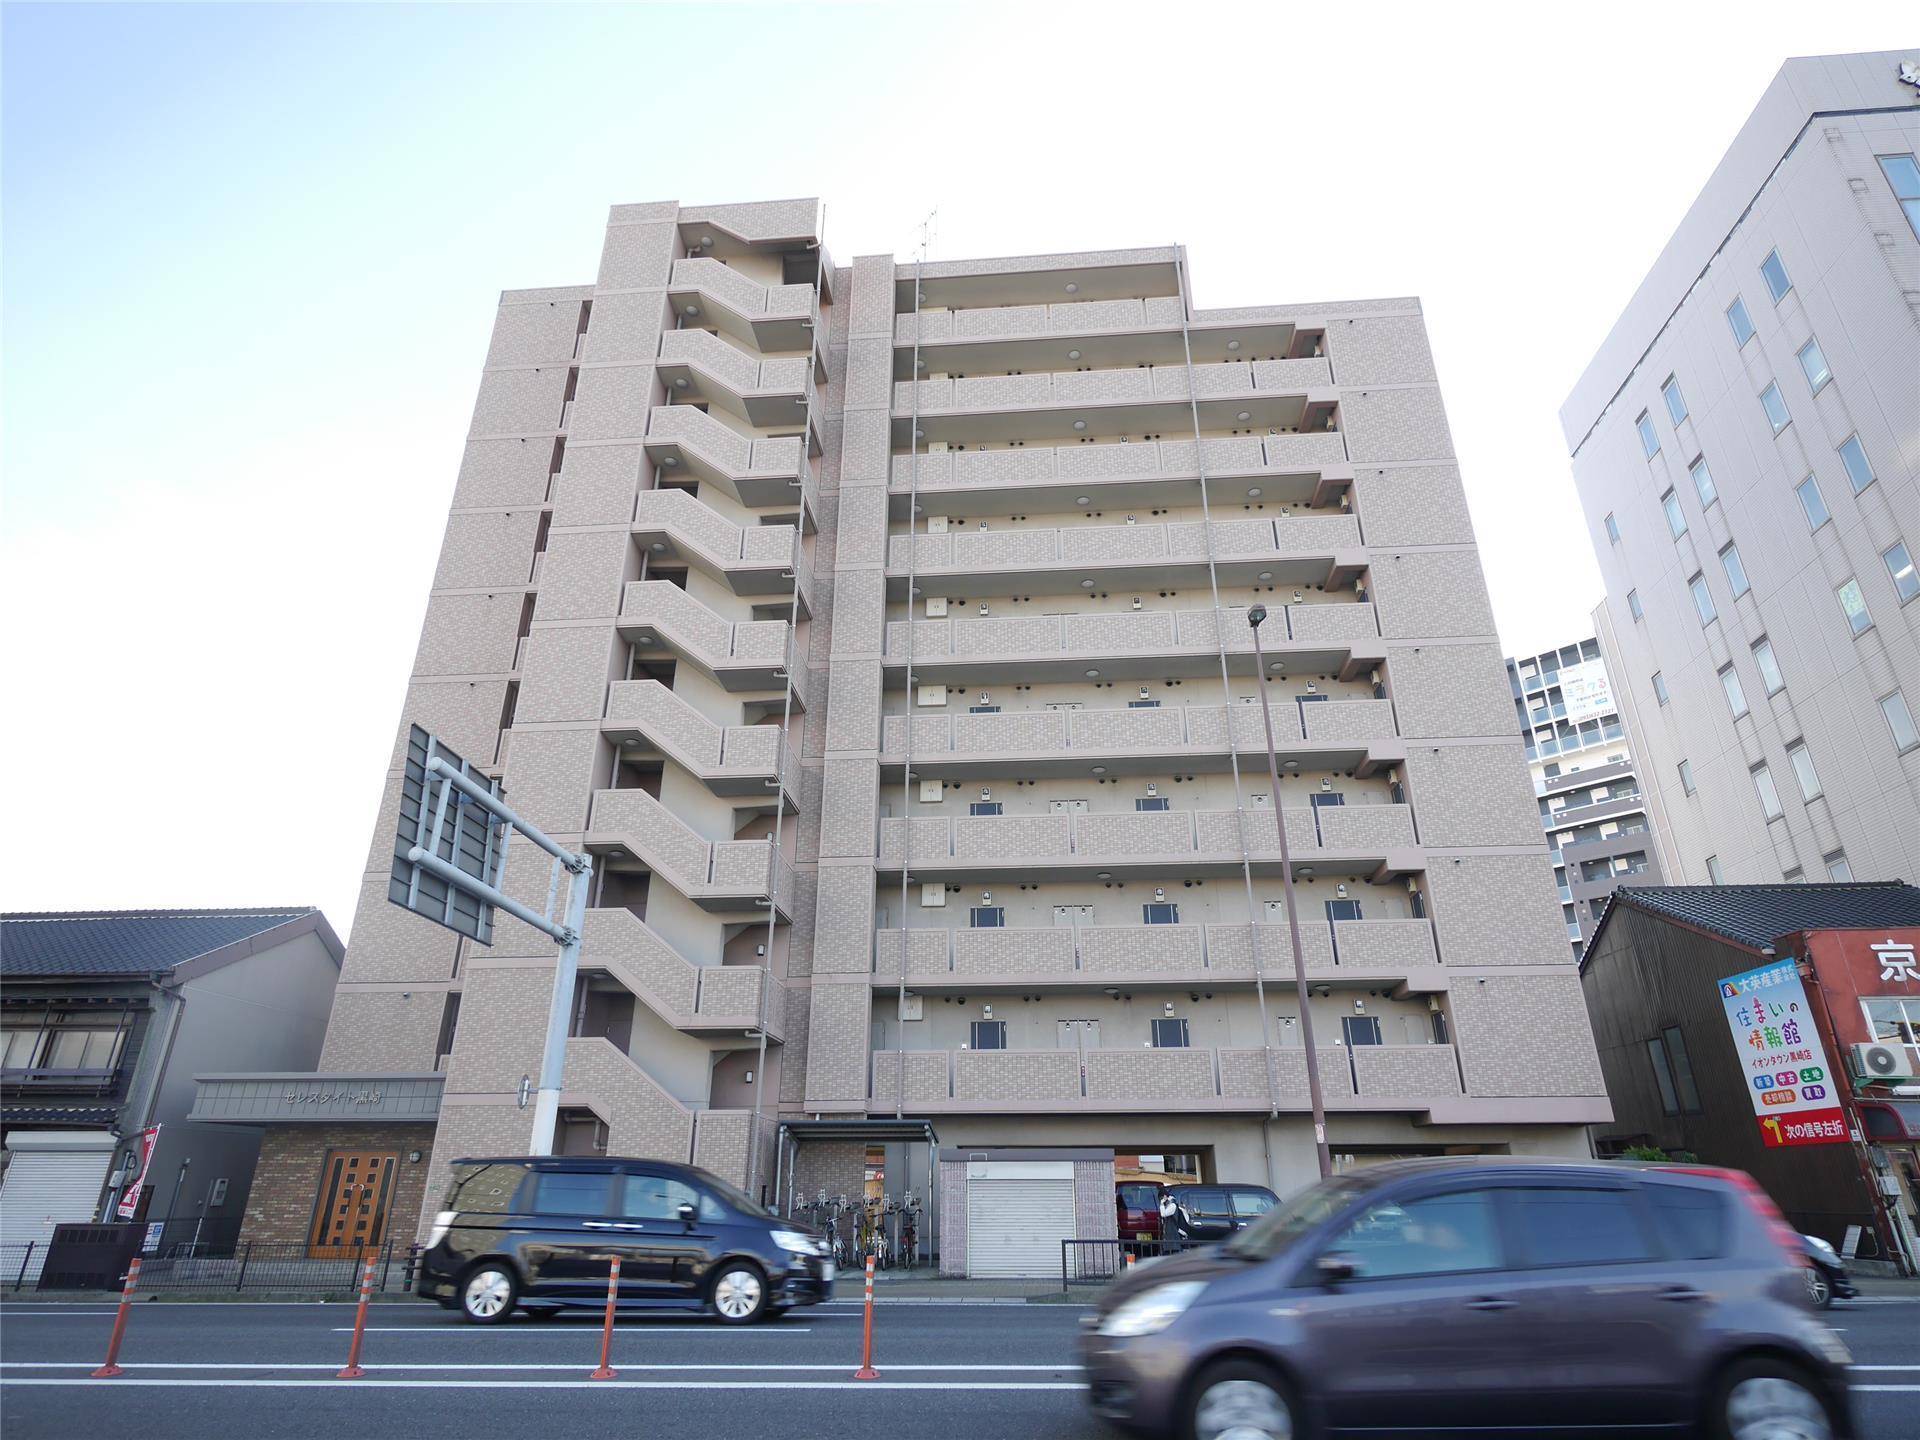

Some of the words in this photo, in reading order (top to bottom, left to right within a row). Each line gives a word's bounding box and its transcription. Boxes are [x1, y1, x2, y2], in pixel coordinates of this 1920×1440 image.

[1870, 939, 1920, 982] 京
[1736, 996, 1799, 1028] 住まいの
[1748, 1018, 1802, 1051] 情報館
[1778, 1073, 1796, 1085] 中古
[1803, 1069, 1822, 1081] 土地
[1784, 1120, 1844, 1139] 次の信号左折
